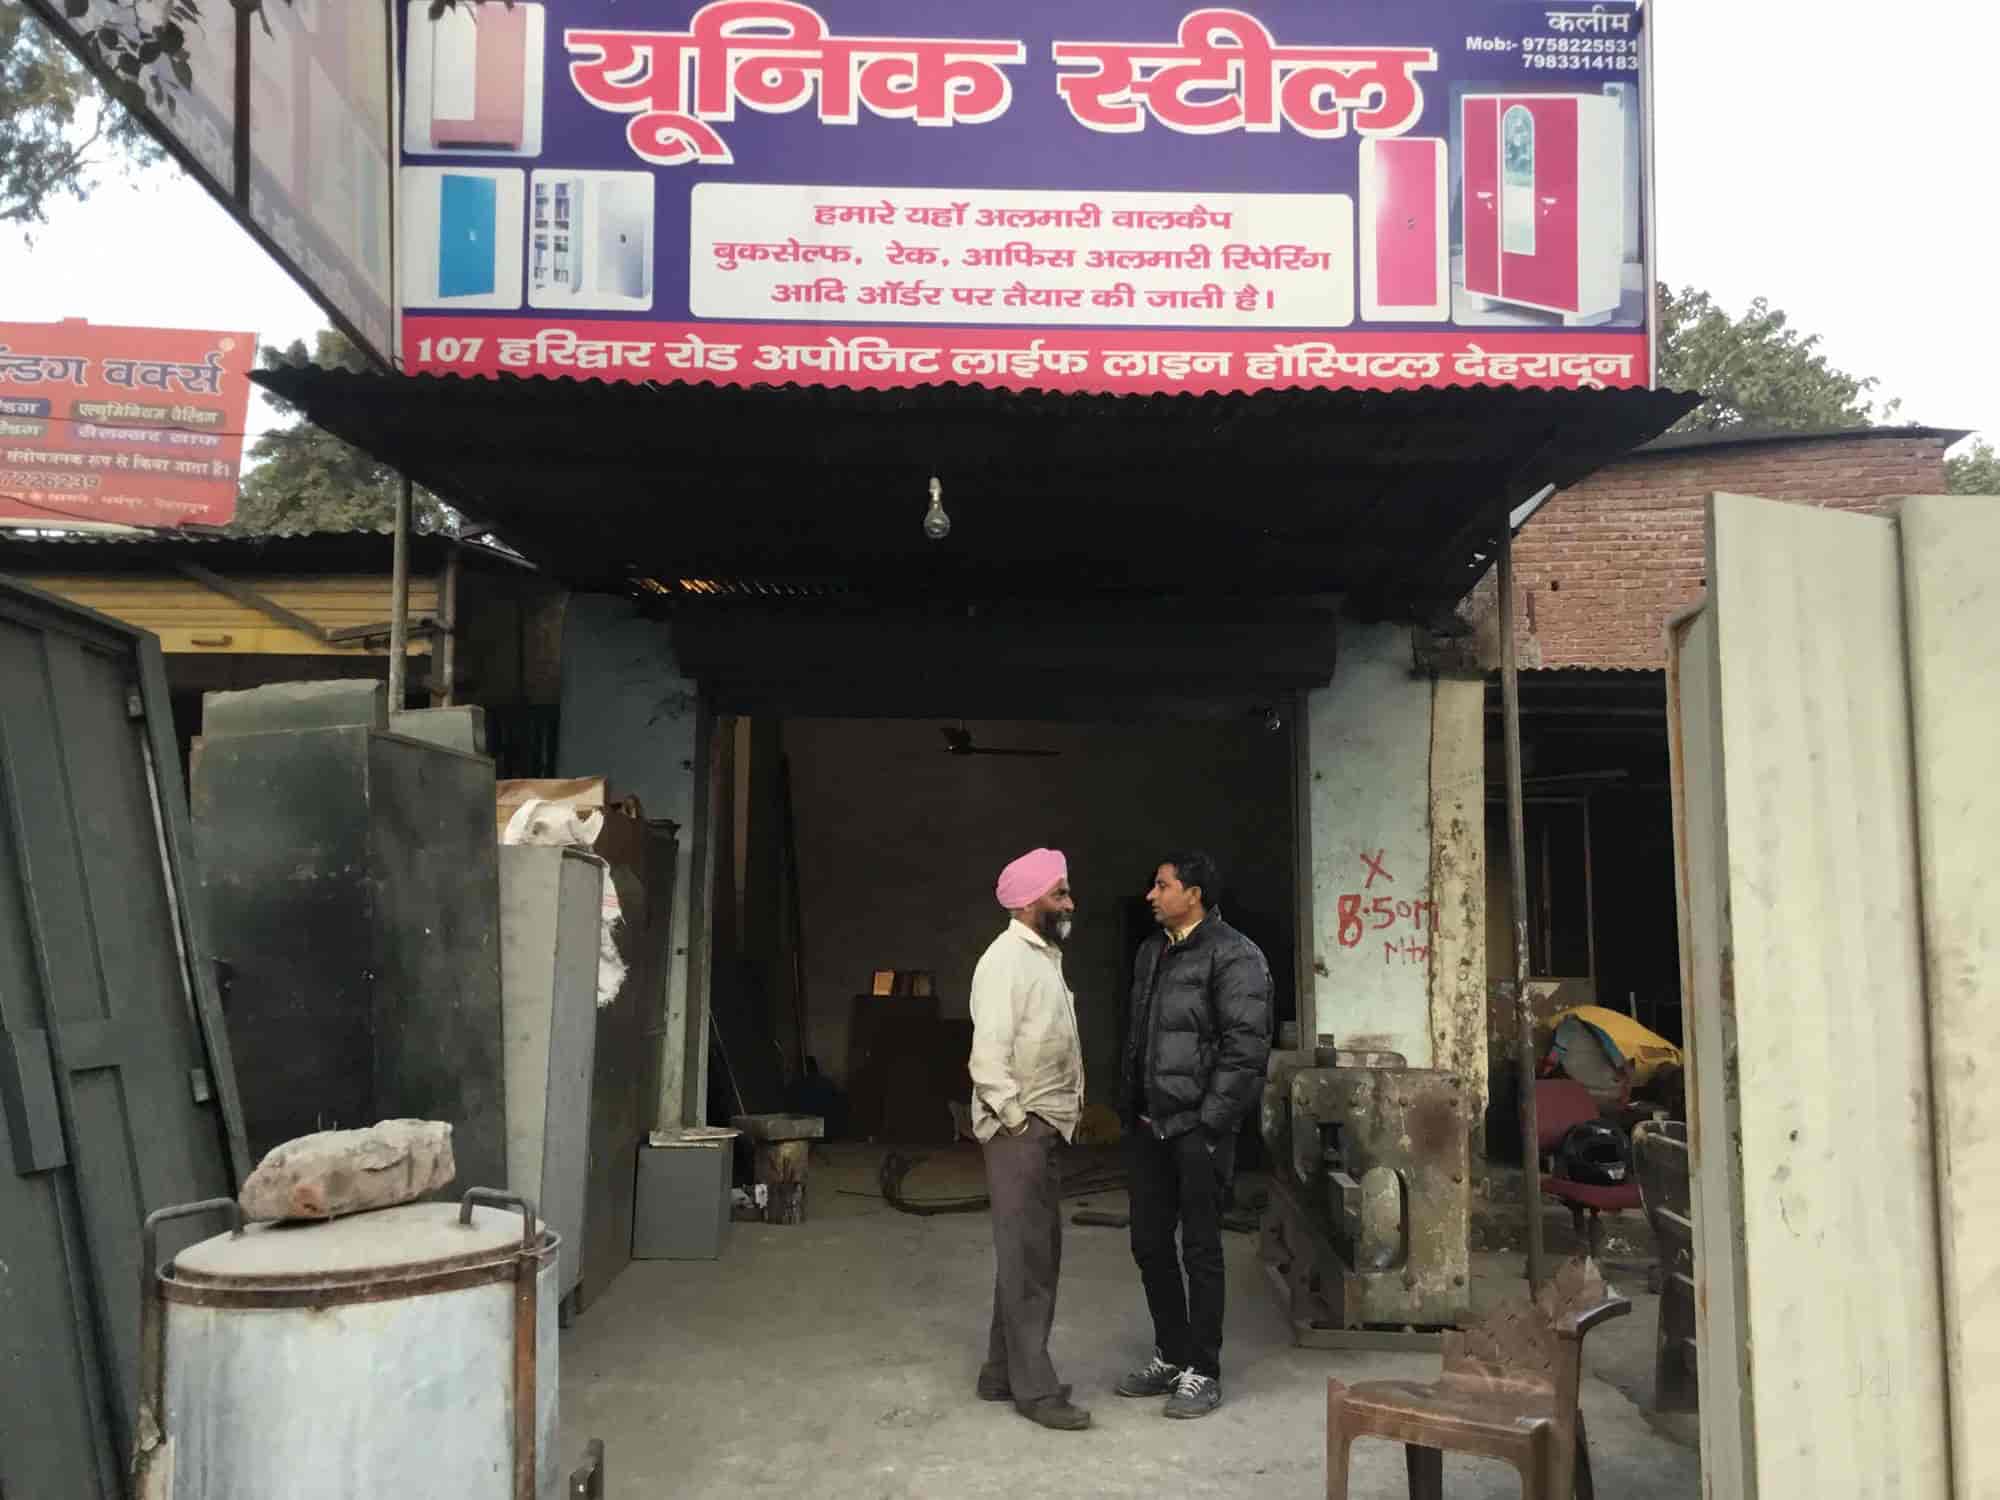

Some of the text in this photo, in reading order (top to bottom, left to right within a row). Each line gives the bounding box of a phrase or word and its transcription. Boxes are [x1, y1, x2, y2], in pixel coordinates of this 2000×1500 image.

[1545, 4, 1631, 32] कलीम
[1522, 37, 1637, 53] 9758225531
[1522, 53, 1638, 70] 7983314183
[564, 0, 1438, 165] यूनिक स्टील
[814, 200, 898, 225] हमारे
[975, 202, 1102, 228] अलमारी
[961, 241, 1076, 268] आफिस
[1085, 244, 1211, 270] अलमारी
[770, 278, 848, 304] आदि
[856, 280, 944, 306] ऑर्डर
[952, 286, 997, 306] पर
[1003, 281, 1085, 308] तैयार
[1092, 283, 1136, 309] की
[1144, 284, 1224, 309] जाती
[417, 328, 1635, 392] 107 हरिद्वार रोड अपोजिट लाईफ लाइन हॉस्पिटल देहरादून
